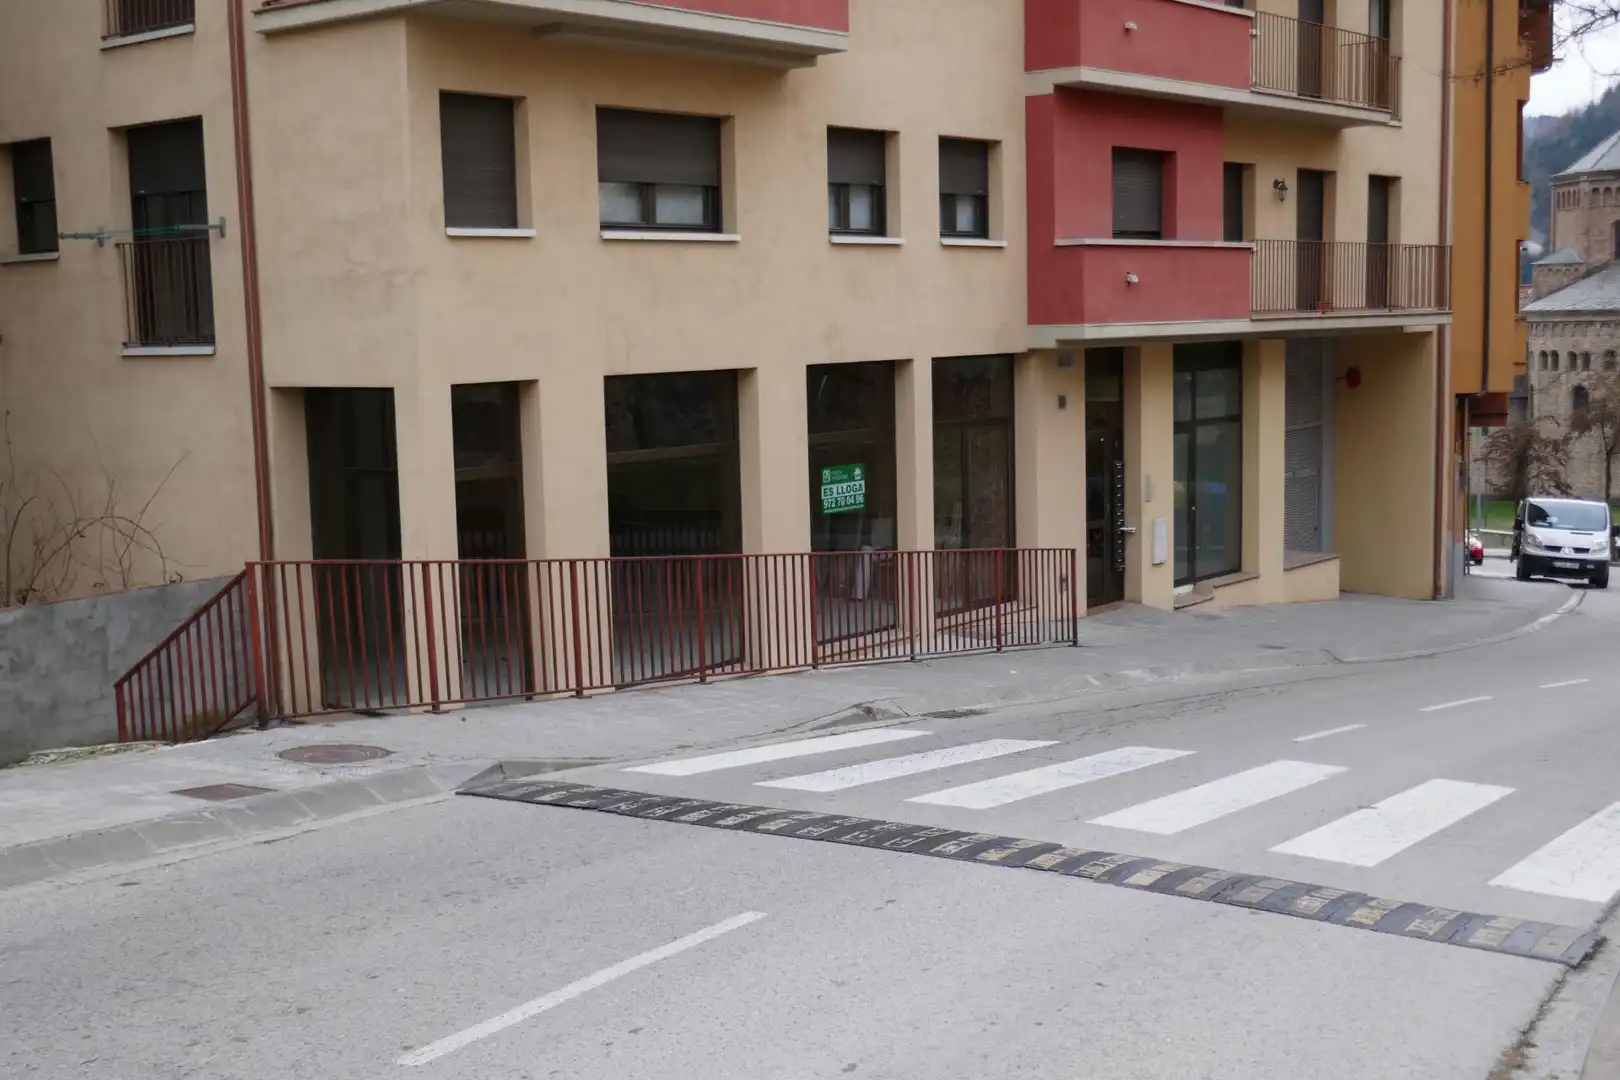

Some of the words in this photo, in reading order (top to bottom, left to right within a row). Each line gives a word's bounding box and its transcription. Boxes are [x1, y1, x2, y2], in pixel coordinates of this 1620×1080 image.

[824, 487, 834, 496] ES
[836, 484, 862, 495] LLOGA
[824, 498, 836, 508] 972
[837, 496, 845, 506] 70
[846, 496, 854, 505] 04
[856, 494, 864, 504] 96
